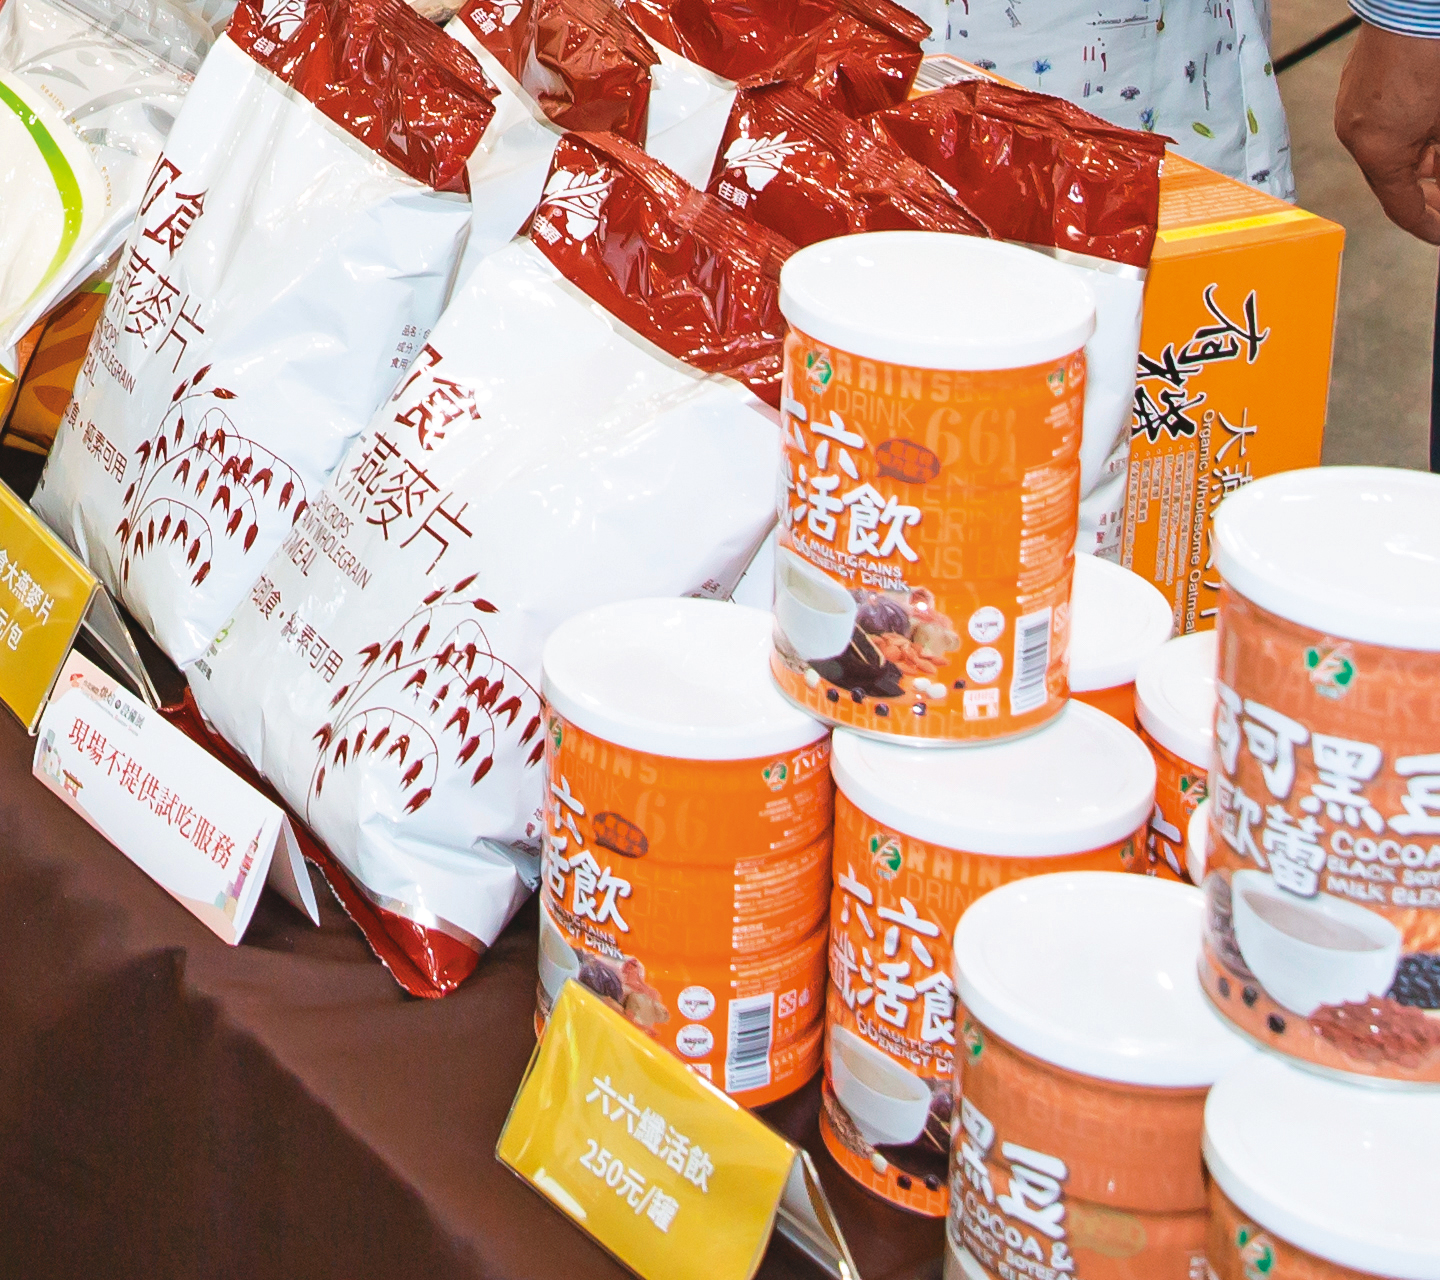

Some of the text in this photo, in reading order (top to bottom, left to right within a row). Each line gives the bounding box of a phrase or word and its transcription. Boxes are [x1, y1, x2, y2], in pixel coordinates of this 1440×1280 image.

[1198, 408, 1216, 473] Organic
[335, 431, 473, 576] 燕麥片
[1191, 473, 1210, 567] Wholesome
[68, 715, 238, 871] 現場不提供試吃服務
[1327, 876, 1388, 903] MILK
[1328, 855, 1398, 884] BLACK
[878, 1025, 955, 1060] MULTIGRA
[585, 1075, 714, 1193] 六六纖活飲
[579, 1139, 680, 1233] 250元/罐
[965, 1190, 1045, 1263] COCOA
